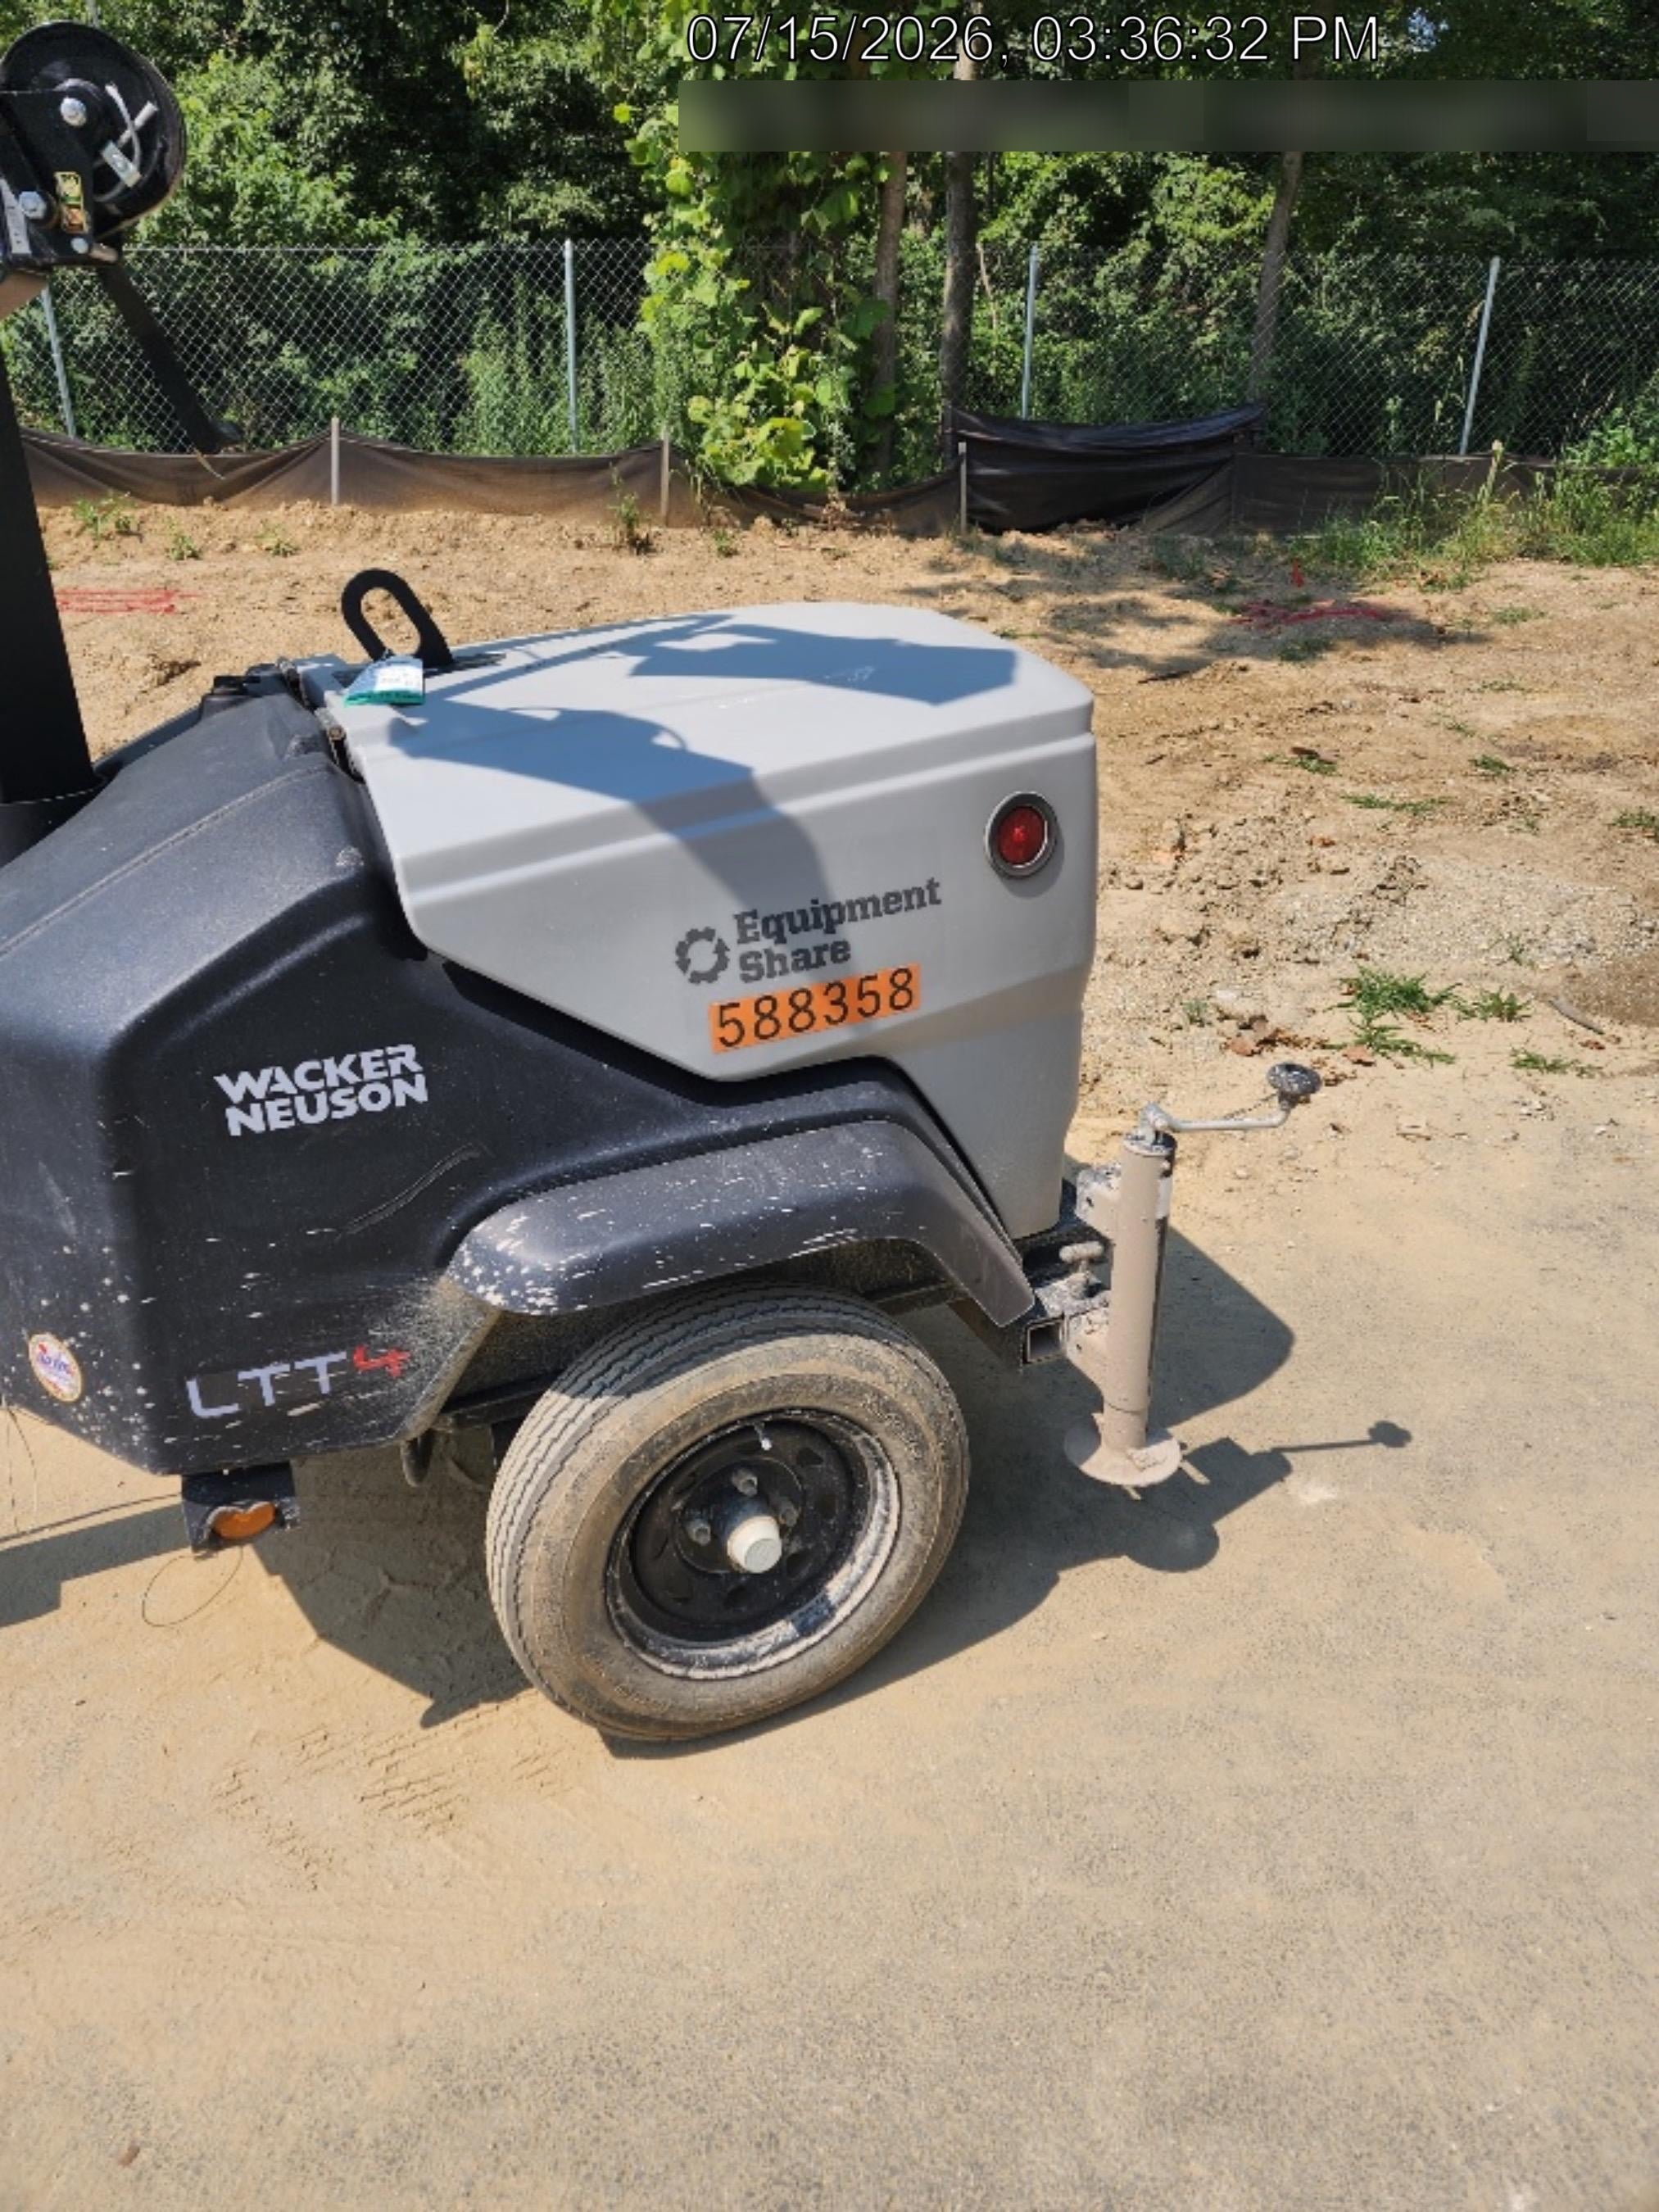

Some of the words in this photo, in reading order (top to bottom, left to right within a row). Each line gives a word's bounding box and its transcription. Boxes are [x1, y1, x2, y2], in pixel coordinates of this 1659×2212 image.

[734, 877, 941, 944] Equipment
[739, 940, 851, 983] Share
[718, 967, 913, 1048] 588358
[214, 1044, 424, 1104] WACKER
[225, 1073, 428, 1136] NEUSON
